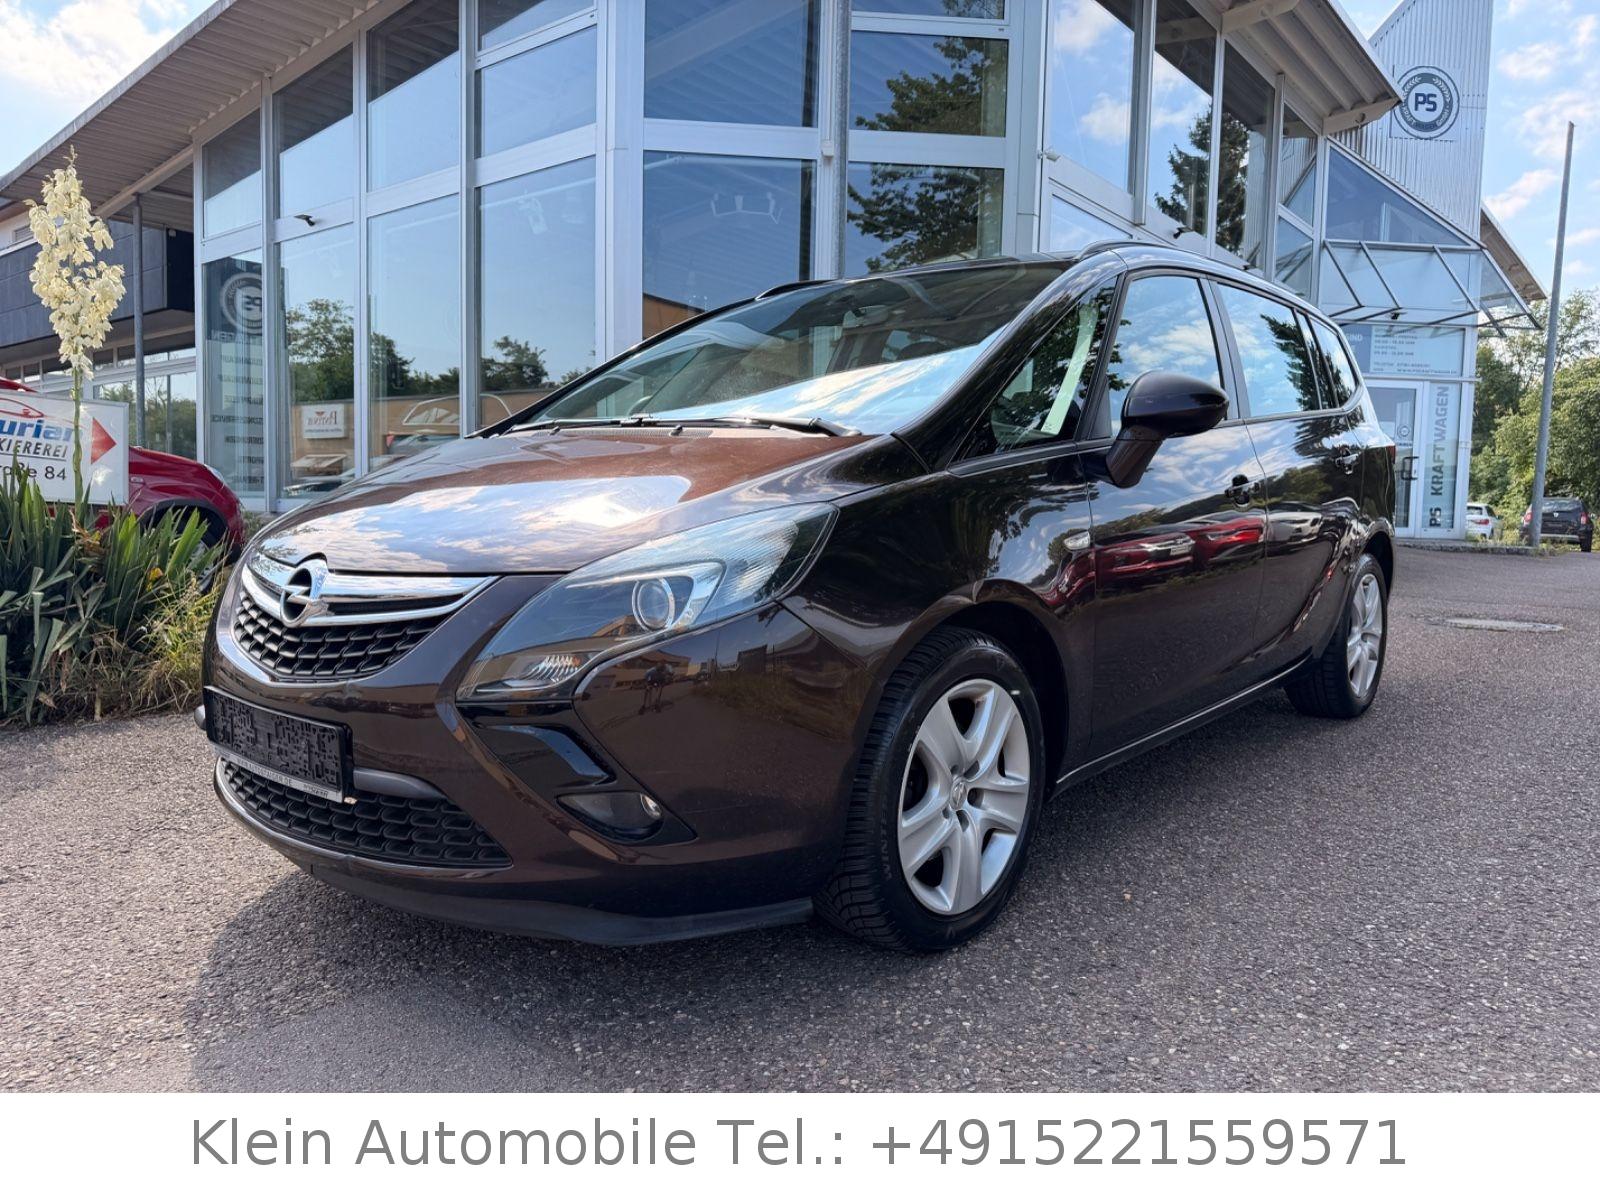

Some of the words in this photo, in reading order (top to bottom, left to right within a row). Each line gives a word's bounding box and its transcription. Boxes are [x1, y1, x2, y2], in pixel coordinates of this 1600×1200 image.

[1414, 92, 1437, 112] PS
[1431, 386, 1449, 496] KRAFTWAGEN
[45, 465, 66, 480] 84
[1429, 507, 1442, 527] PS
